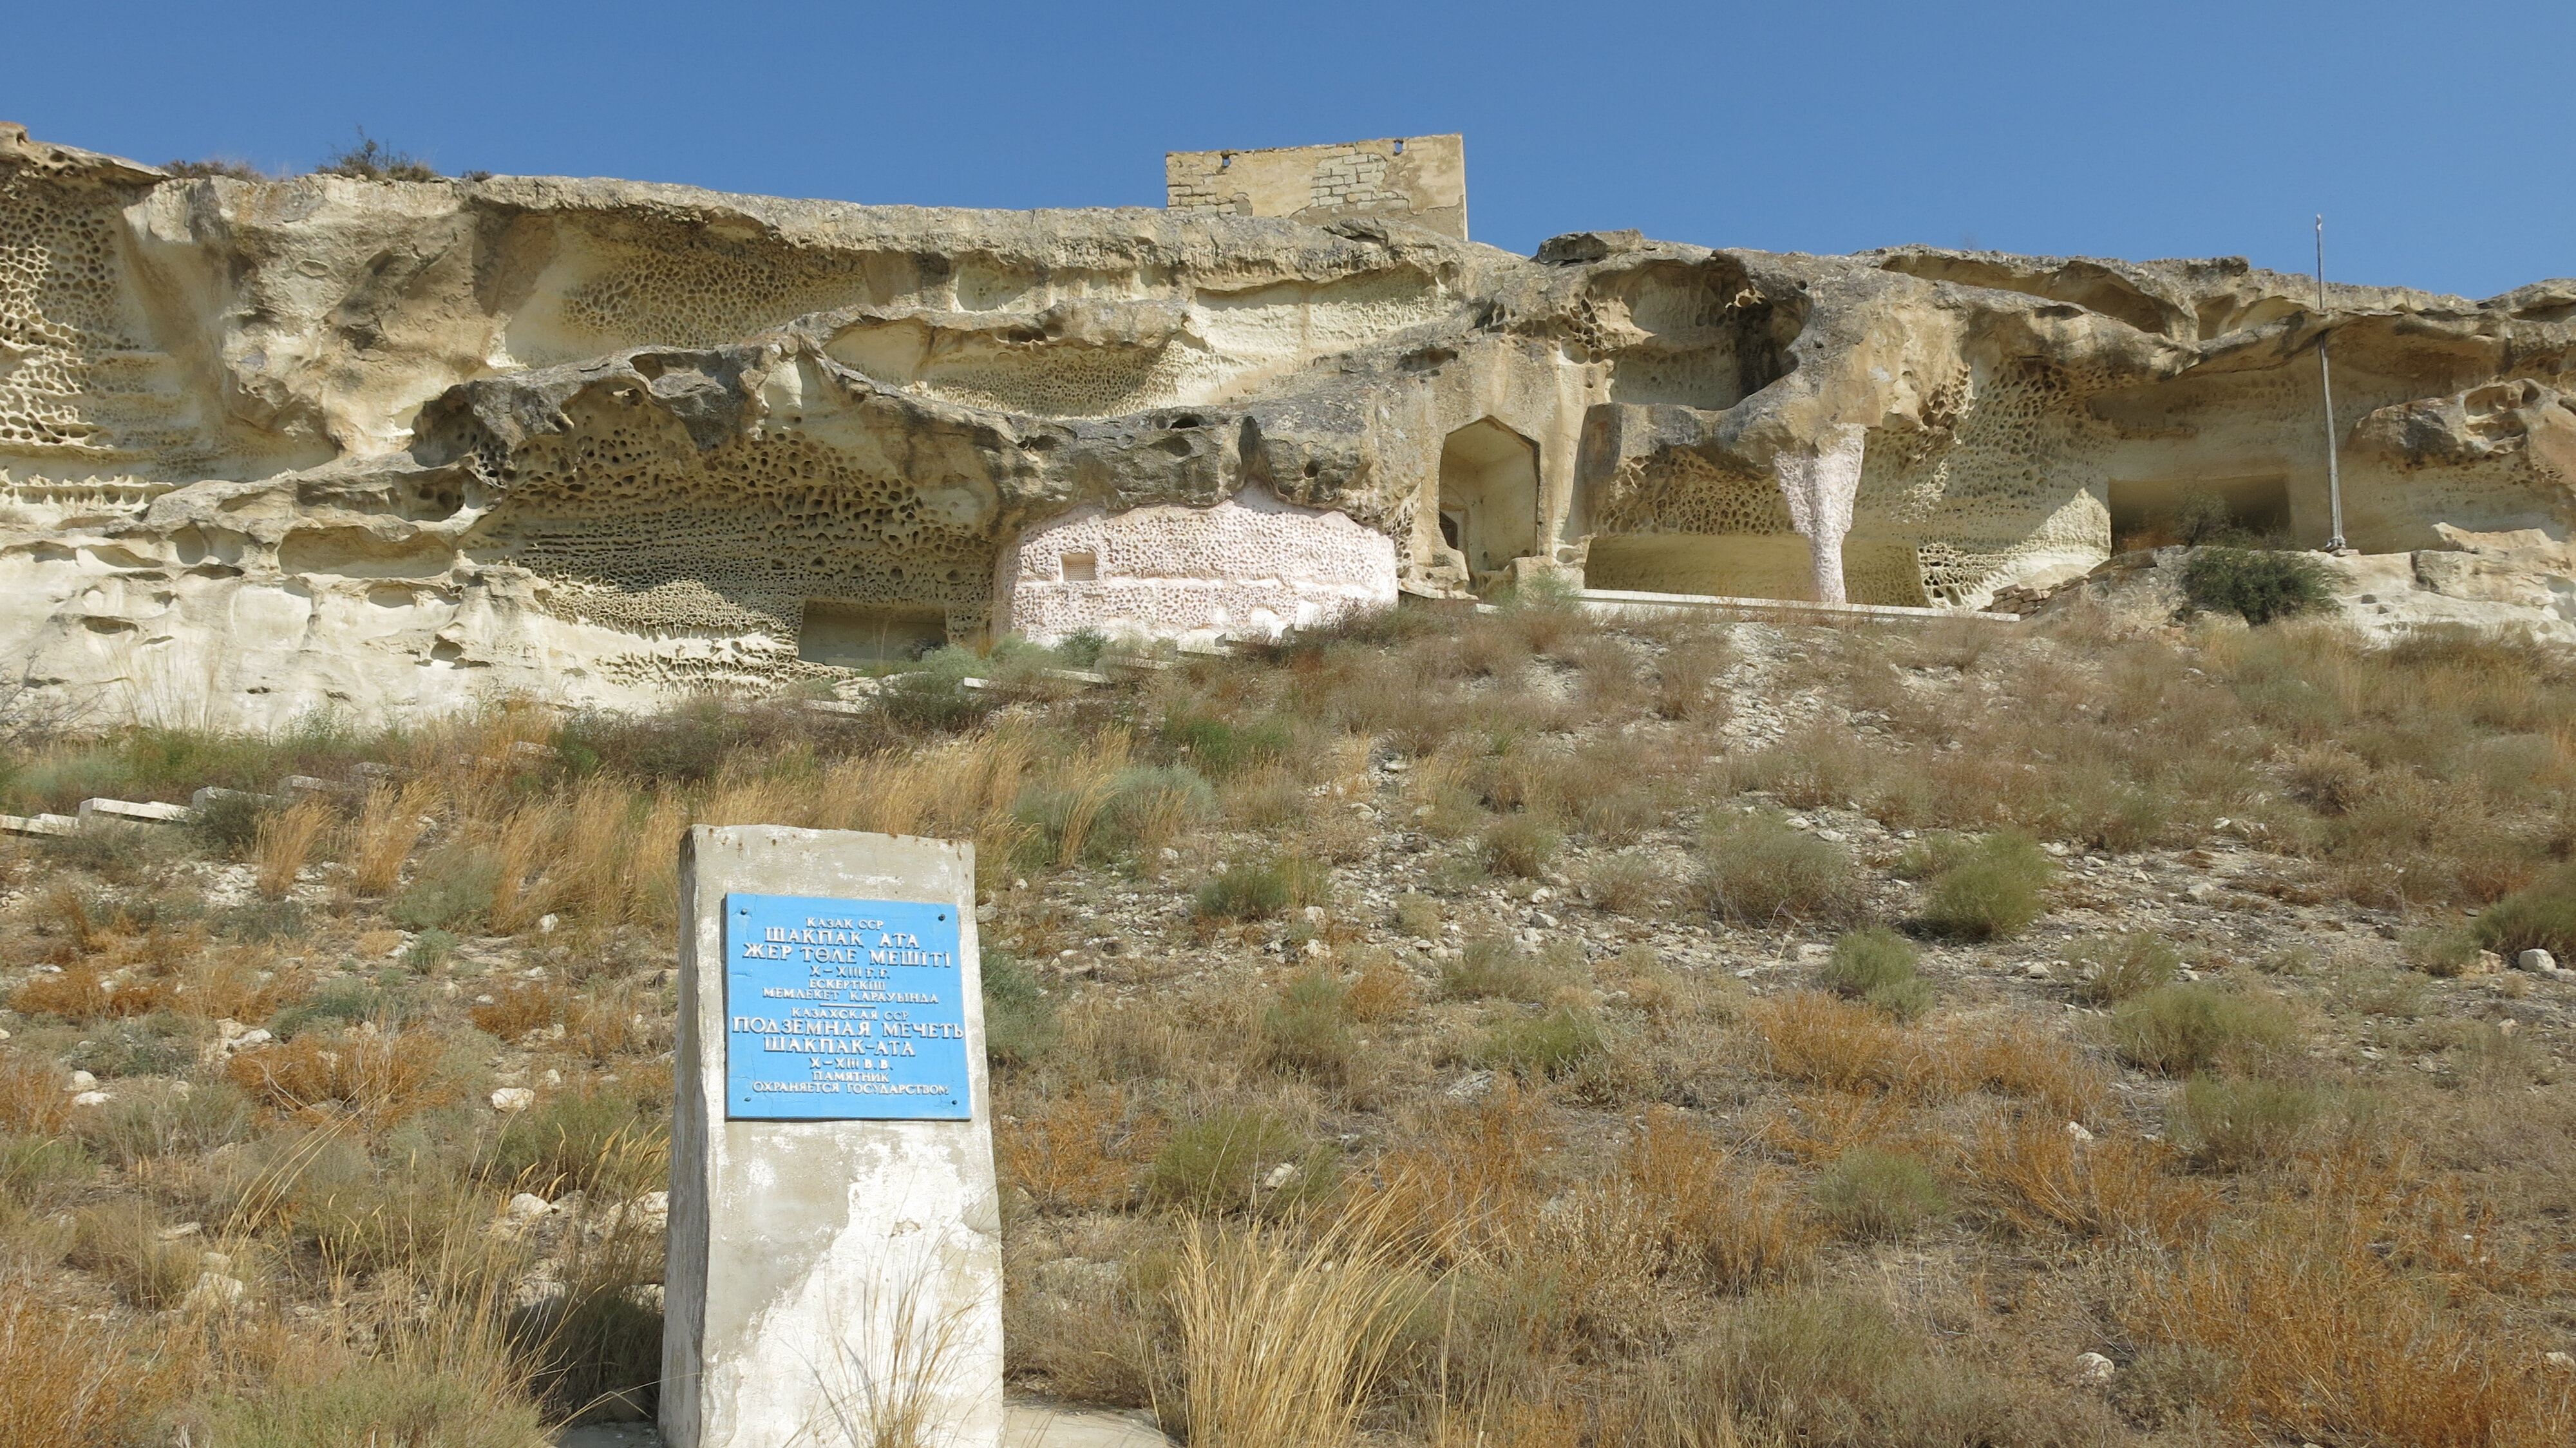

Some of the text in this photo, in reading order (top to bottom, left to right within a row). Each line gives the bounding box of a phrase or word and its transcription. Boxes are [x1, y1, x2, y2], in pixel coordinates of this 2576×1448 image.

[858, 920, 884, 930] ССР
[878, 932, 920, 949] АТА
[743, 942, 793, 960] ЖЕР
[800, 946, 857, 964] ТӨЛЕ
[762, 987, 839, 1001] МЕМЛЕКЕТ
[791, 1007, 909, 1021] КАЗАХСКАЯ ССР
[733, 1017, 964, 1039] ПОДЗЕМНАЯ МЕЧЕТЬ
[764, 1036, 916, 1056] ШАКПАК-АТА
[812, 1071, 889, 1083] ПАМЯТНИК
[753, 1081, 949, 1095] ОХРАНЯЕТСЯ ГОСУДАРСТВОМ
